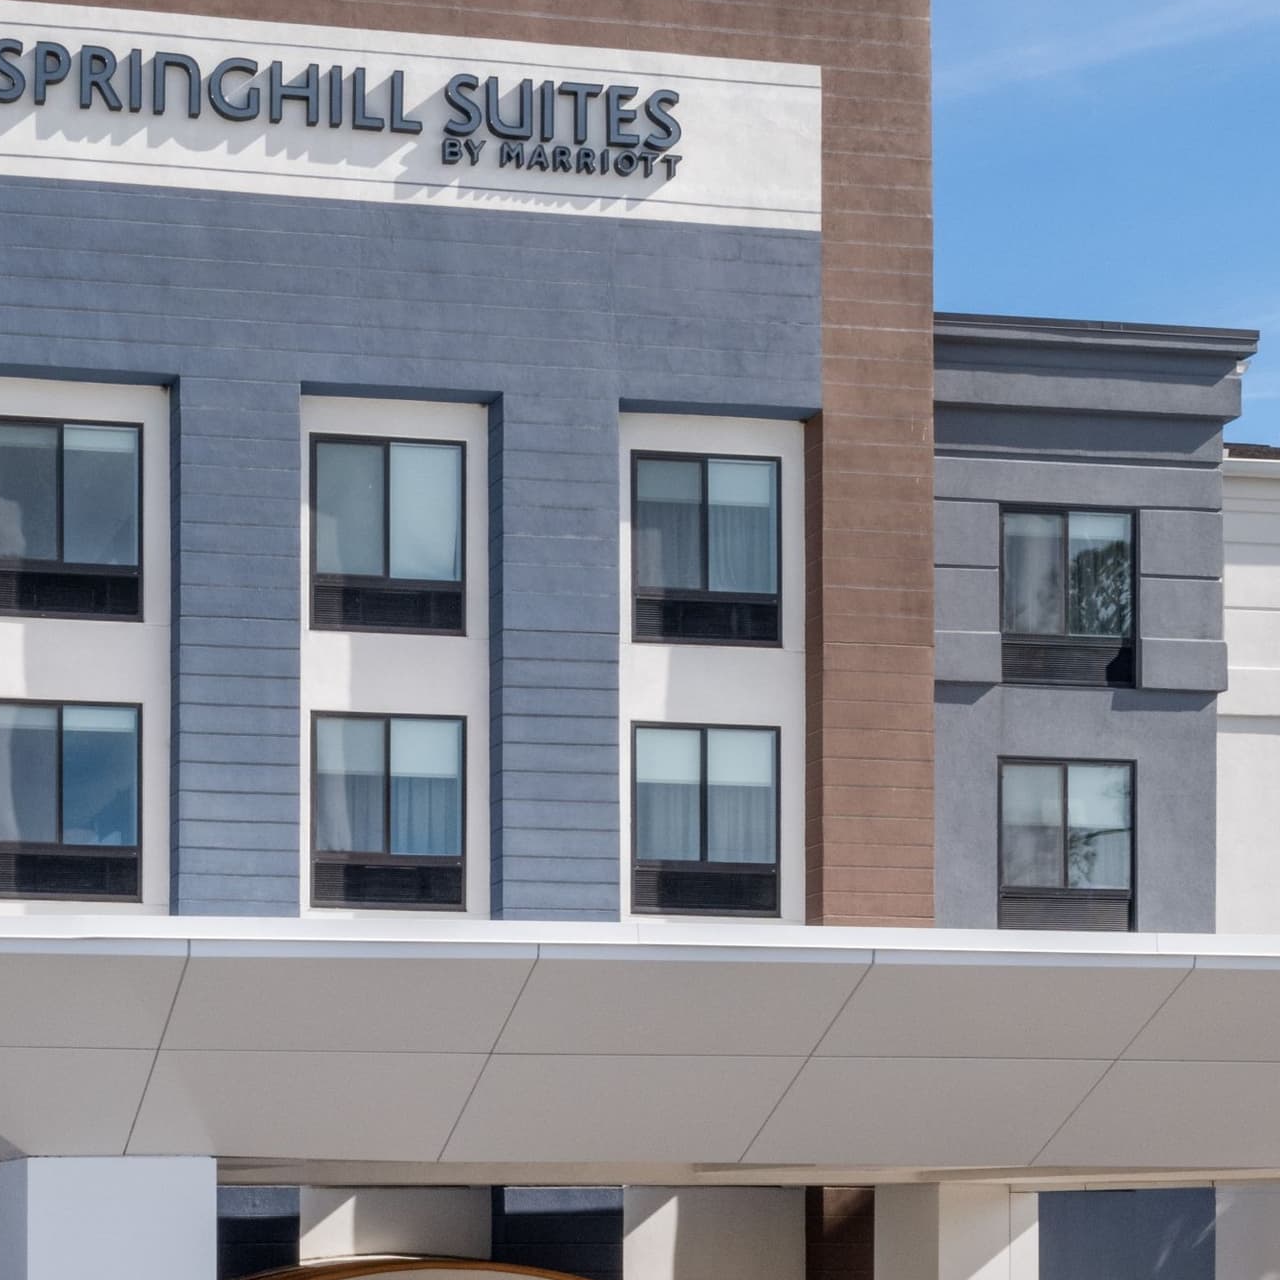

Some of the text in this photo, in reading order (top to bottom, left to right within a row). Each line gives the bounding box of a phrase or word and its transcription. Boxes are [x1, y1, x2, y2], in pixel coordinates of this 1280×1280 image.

[444, 73, 681, 150] SUITES
[443, 138, 682, 180] BY MARRIOTT
